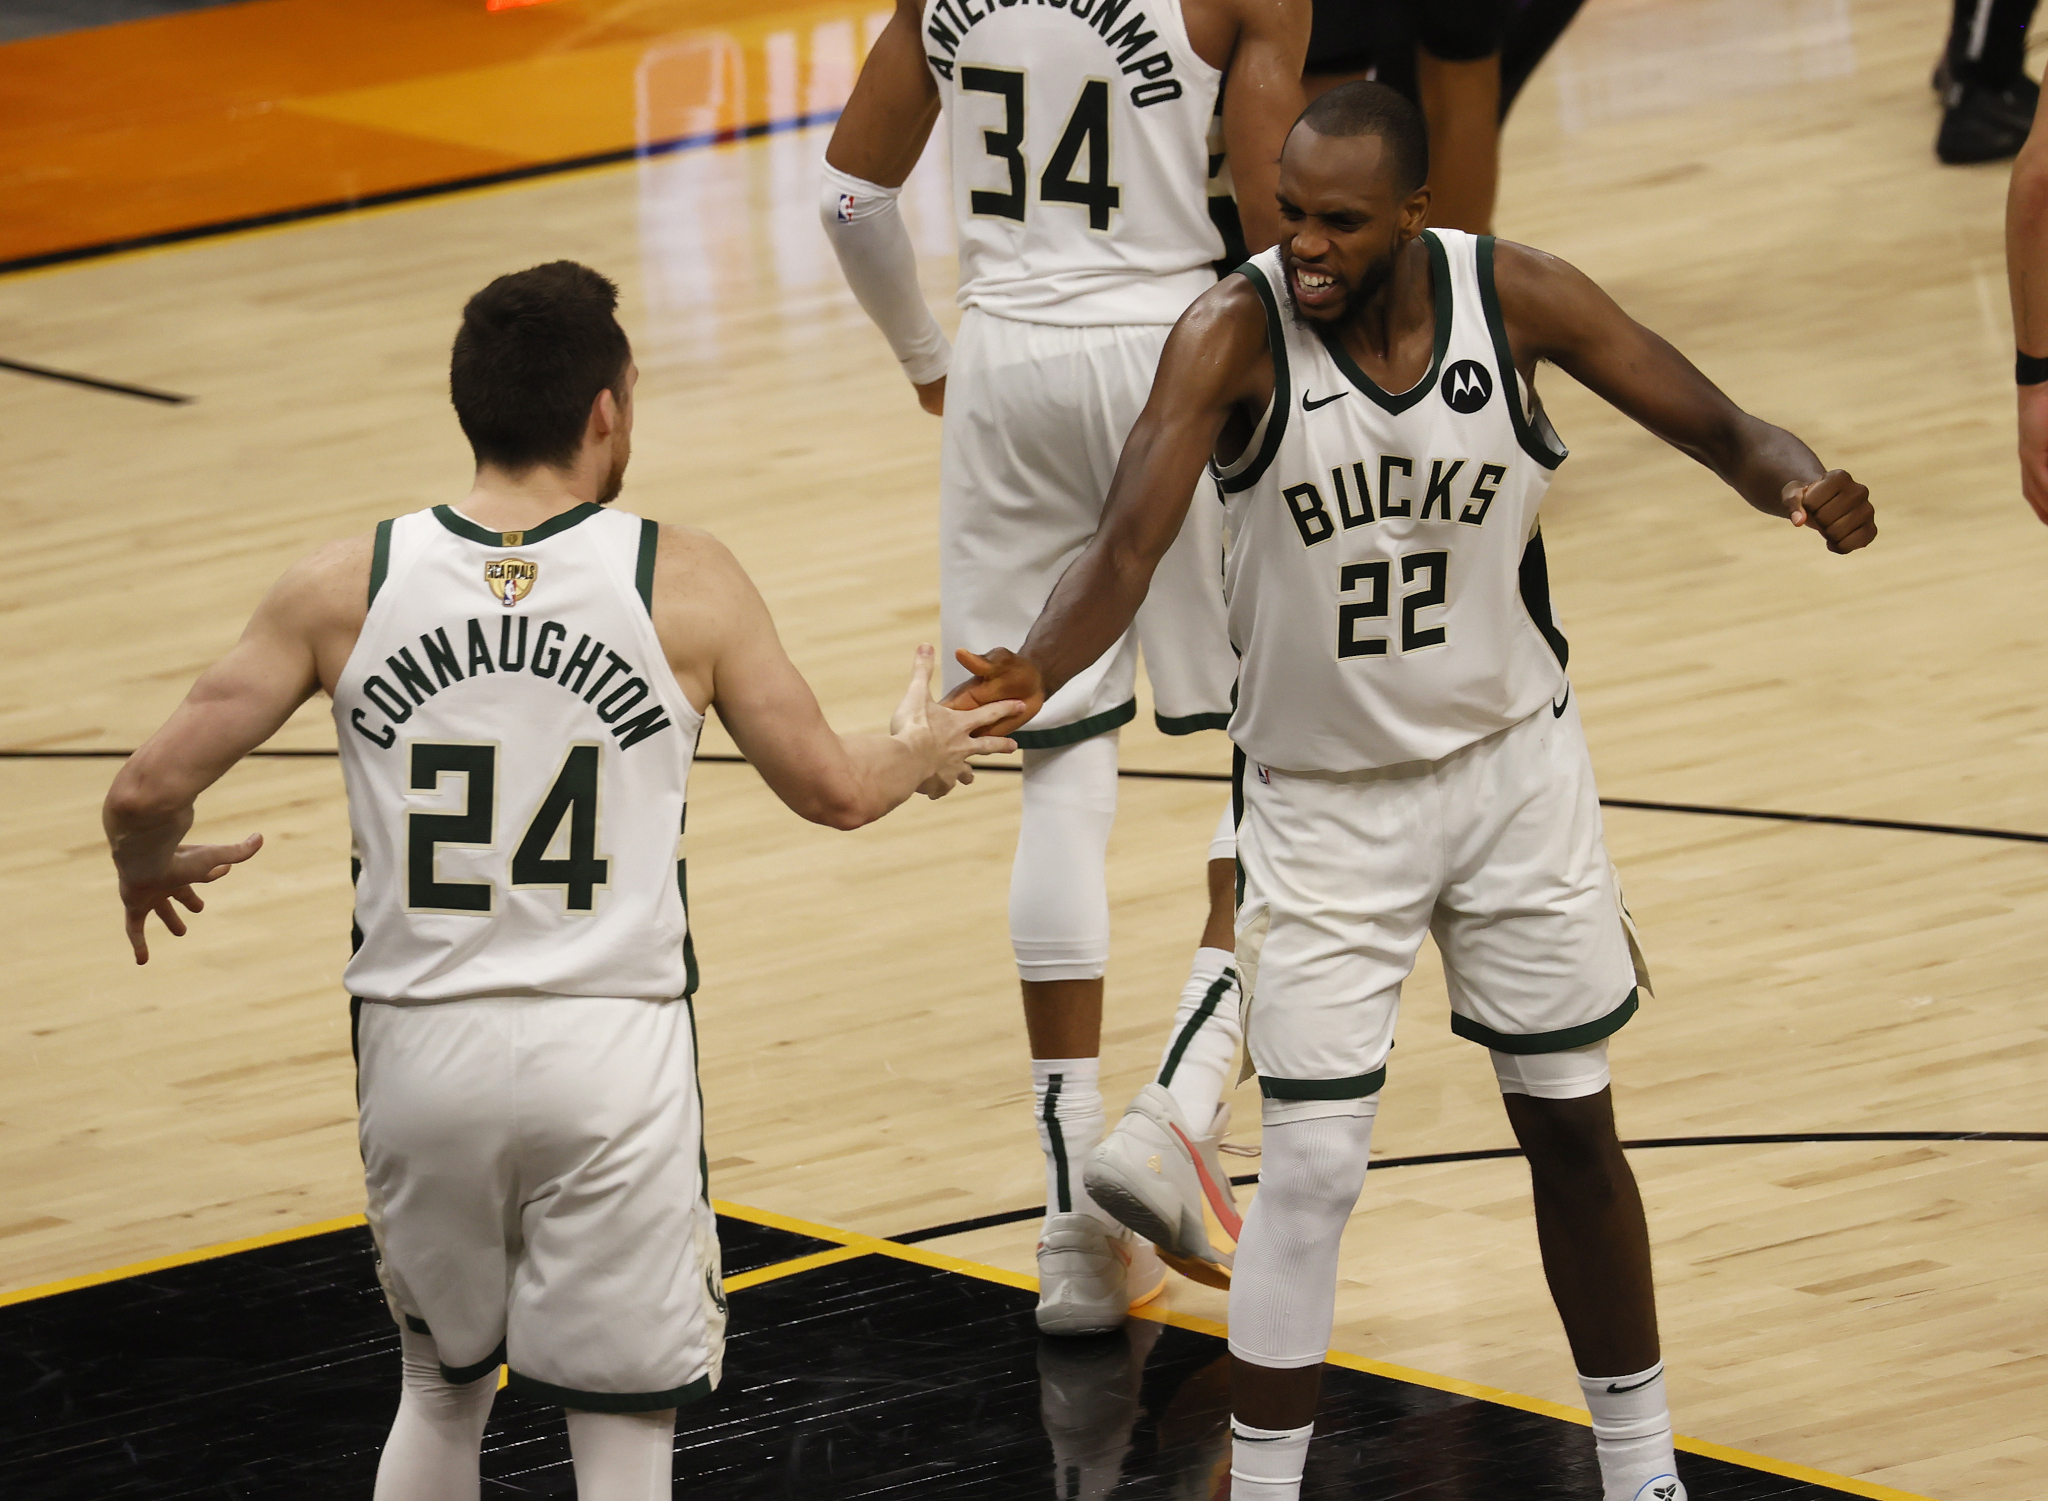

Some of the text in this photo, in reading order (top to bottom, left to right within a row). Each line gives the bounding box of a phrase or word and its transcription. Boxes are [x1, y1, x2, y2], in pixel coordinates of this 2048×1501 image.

[928, 0, 1183, 109] ANTENMPO
[960, 64, 1120, 232] 34
[1282, 454, 1507, 549] BUCKS
[1336, 550, 1449, 662] 22
[351, 615, 672, 751] CONNAUGHTON
[404, 740, 613, 917] 24
